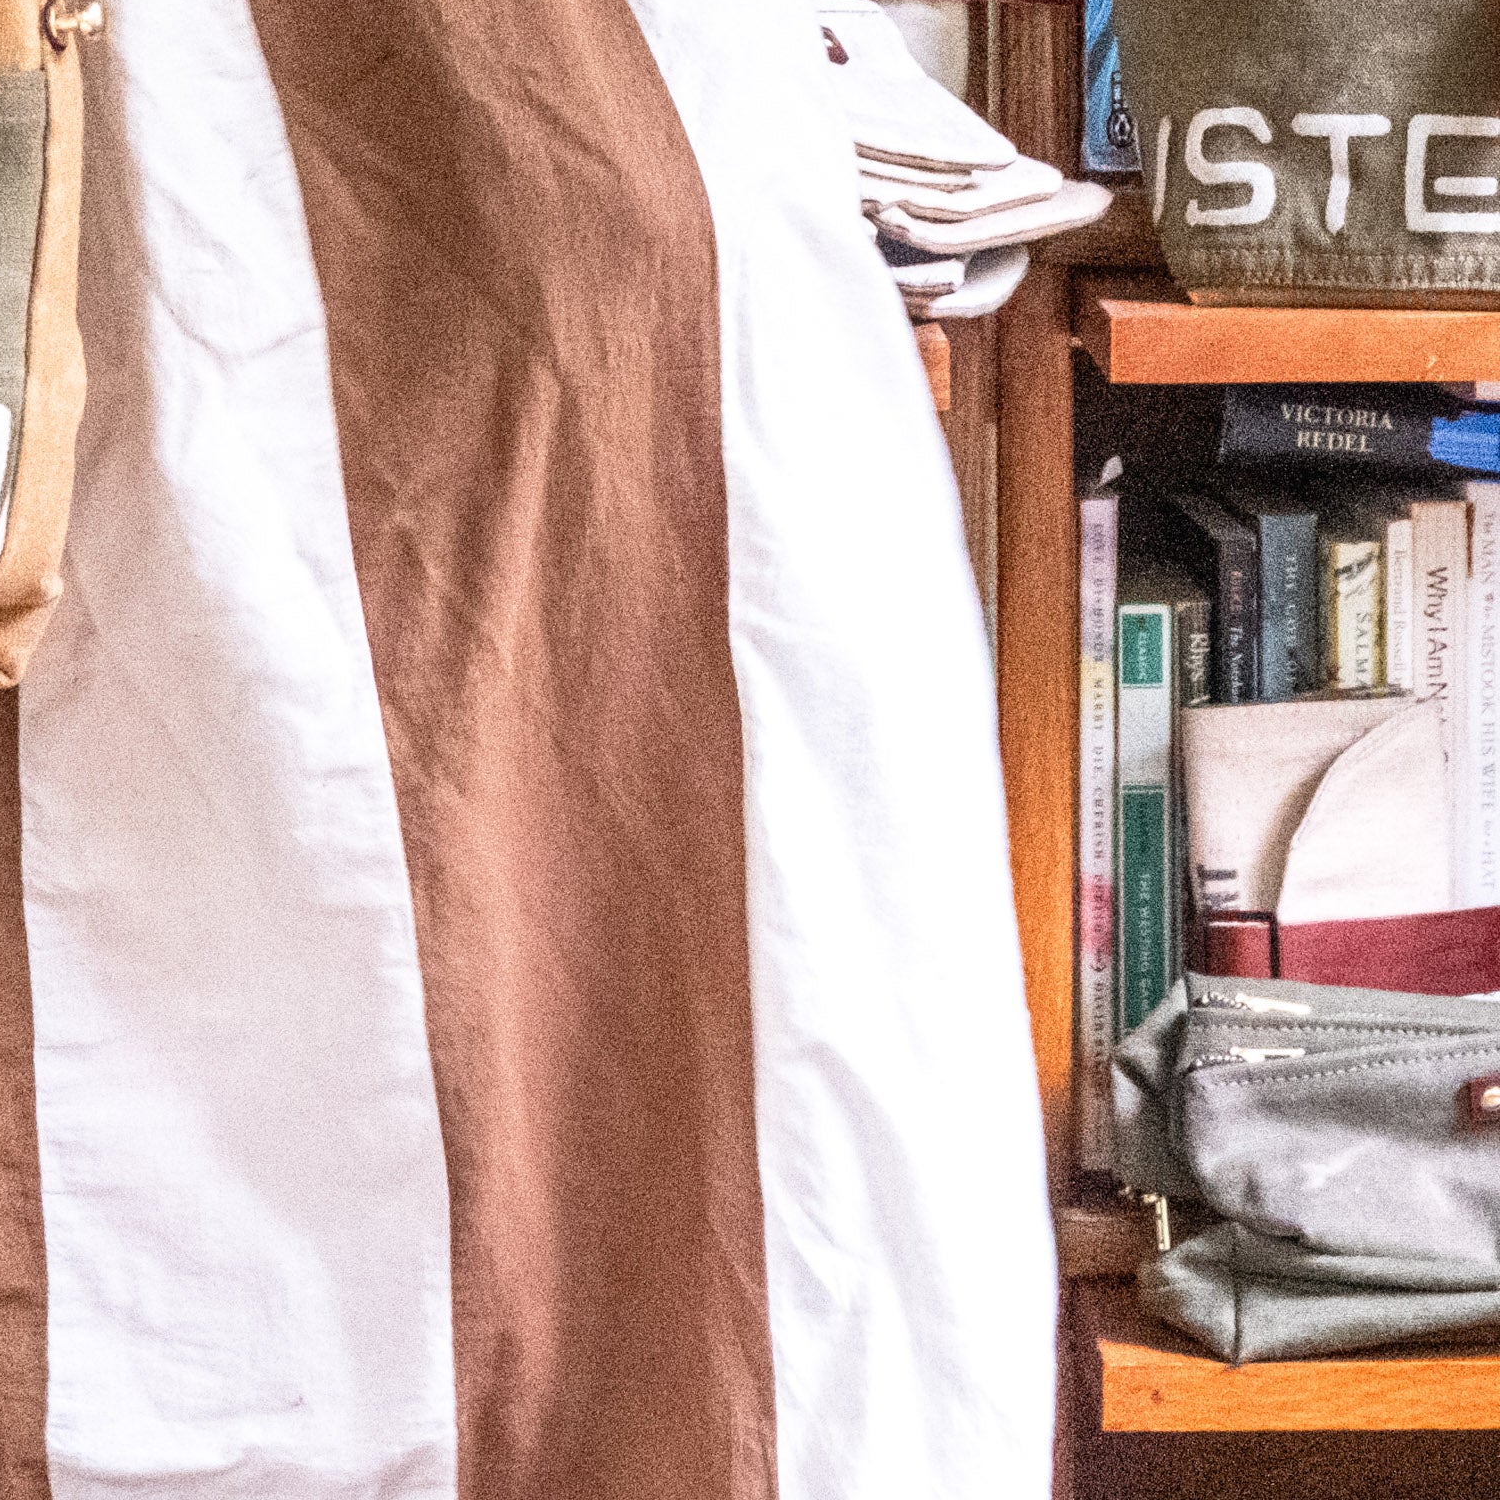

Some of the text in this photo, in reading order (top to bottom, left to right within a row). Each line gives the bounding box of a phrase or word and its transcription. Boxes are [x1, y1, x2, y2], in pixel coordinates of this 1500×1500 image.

[1280, 402, 1395, 431] VICTORIA
[1296, 430, 1375, 453] REDEL
[1423, 565, 1450, 623] Why
[1427, 625, 1449, 633] I
[1427, 637, 1449, 679] Am
